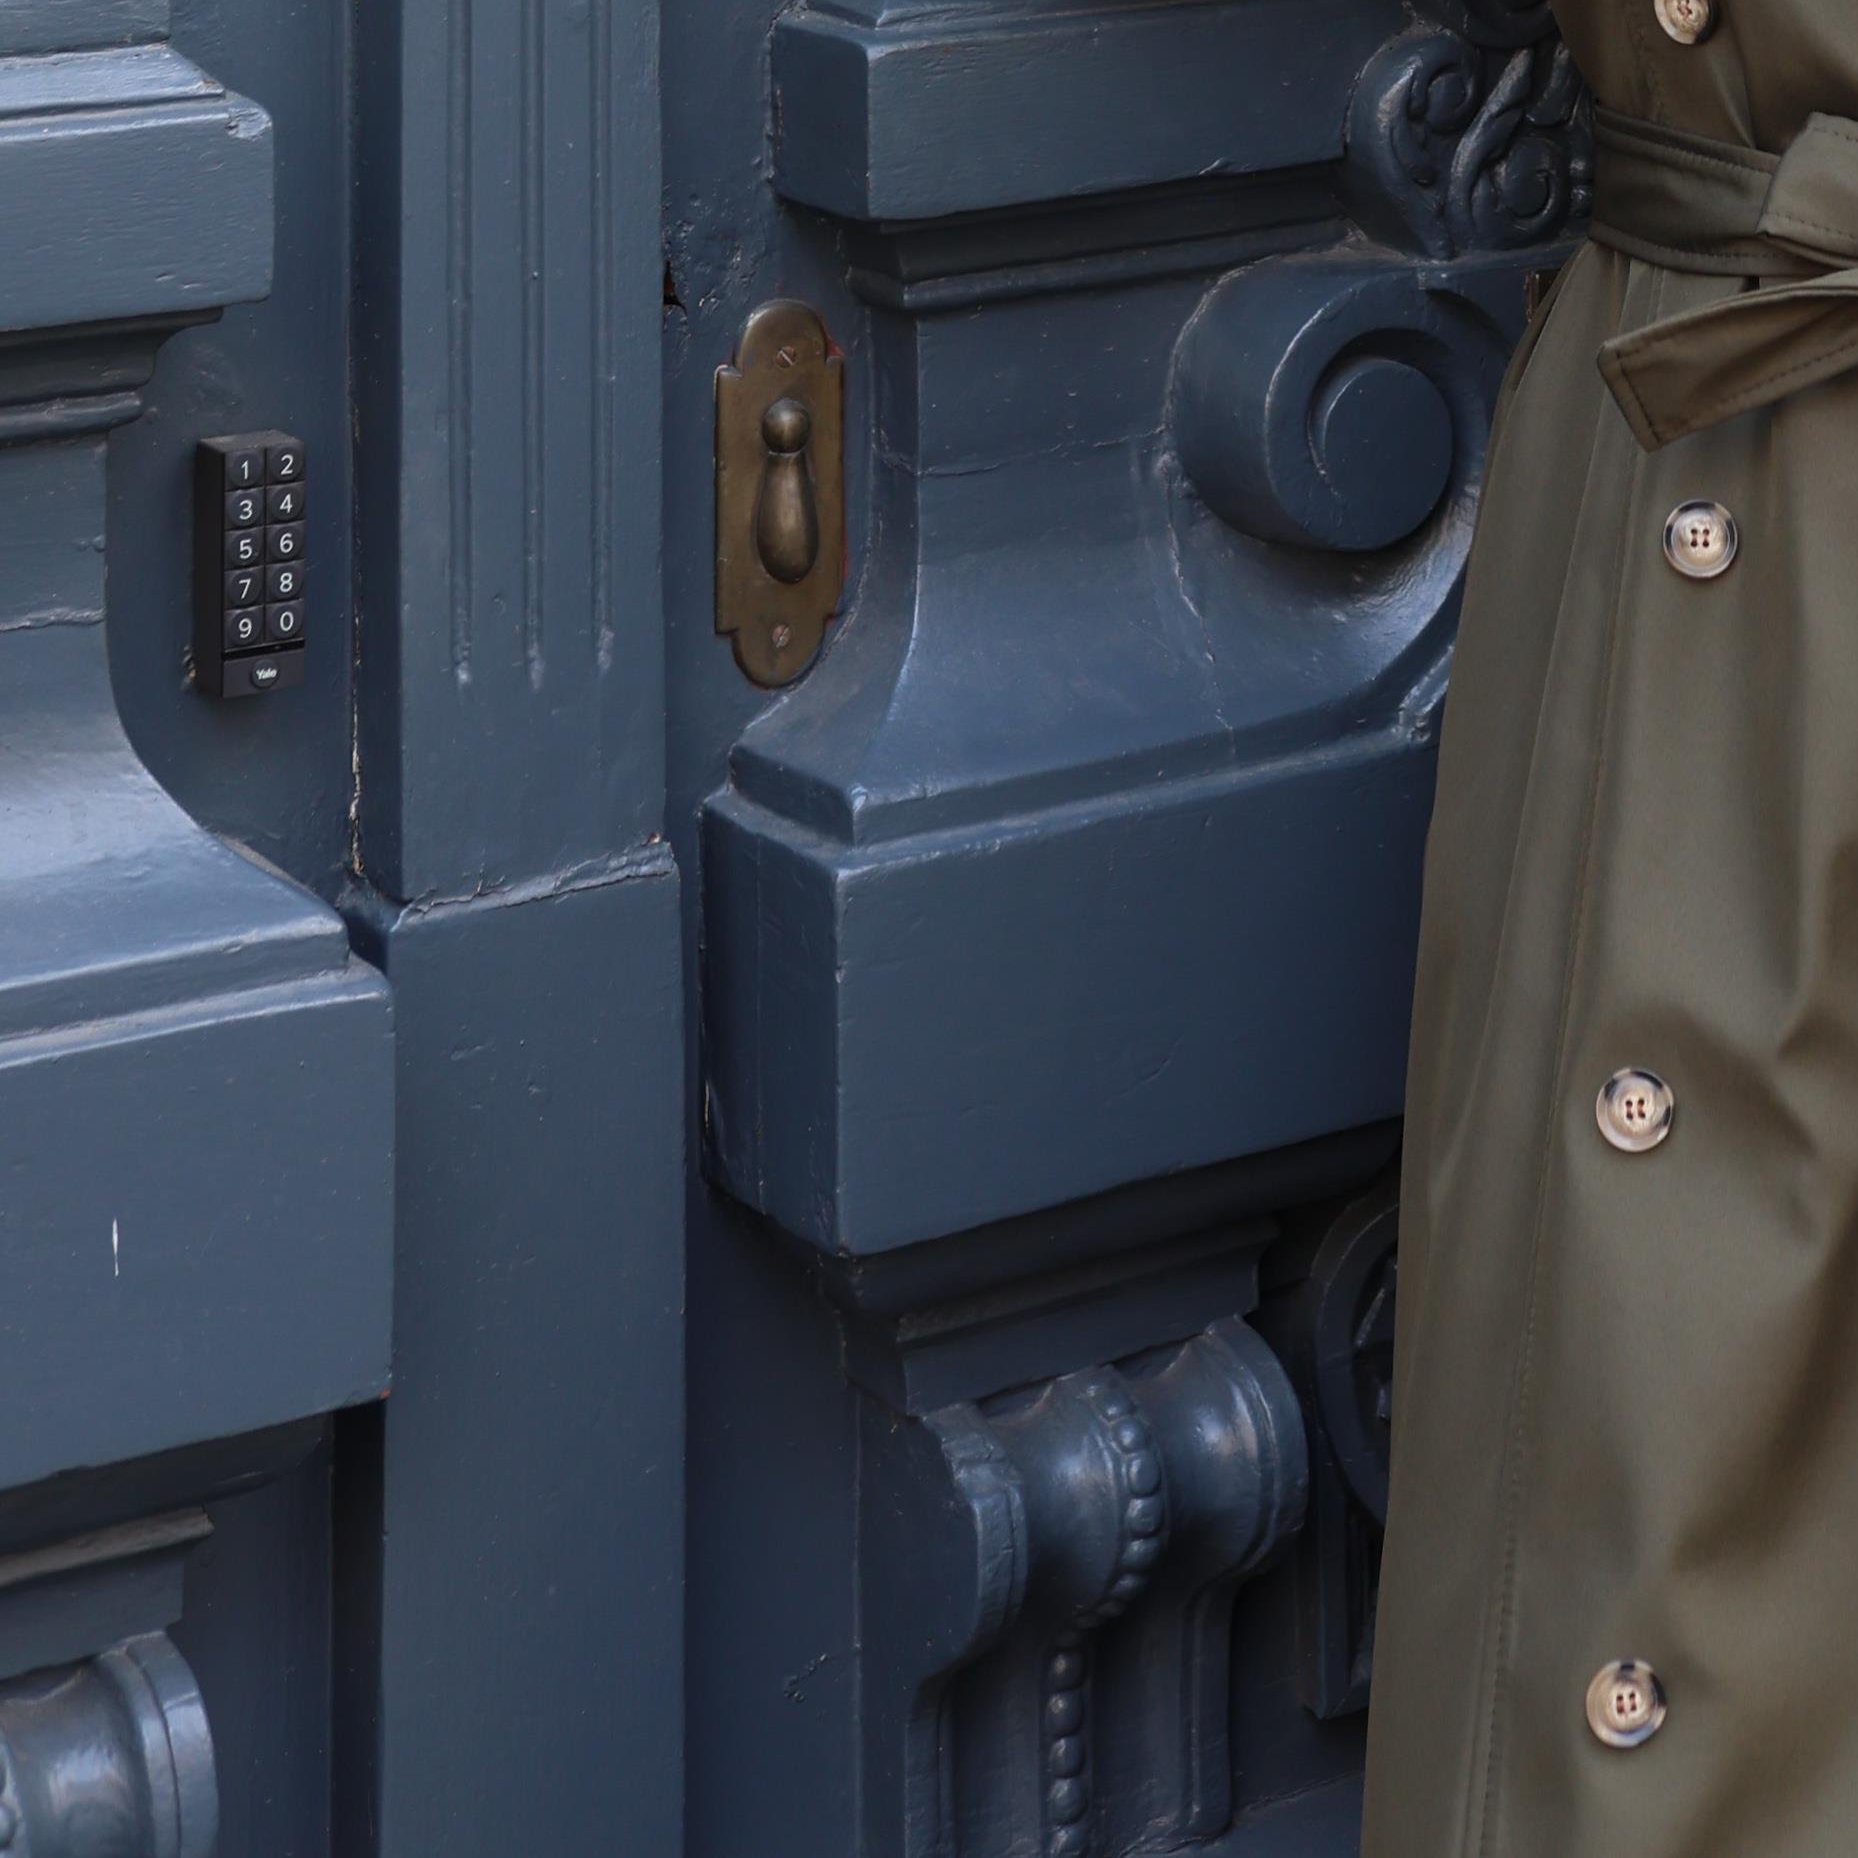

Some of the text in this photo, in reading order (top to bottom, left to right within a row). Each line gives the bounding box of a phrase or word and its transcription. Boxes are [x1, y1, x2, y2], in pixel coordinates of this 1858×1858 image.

[242, 455, 293, 479] 1 2
[240, 494, 292, 519] 3 4
[240, 533, 293, 558] 5 6
[239, 573, 292, 598] 7 8
[239, 612, 293, 638] 9 0
[256, 668, 277, 679] Yale
